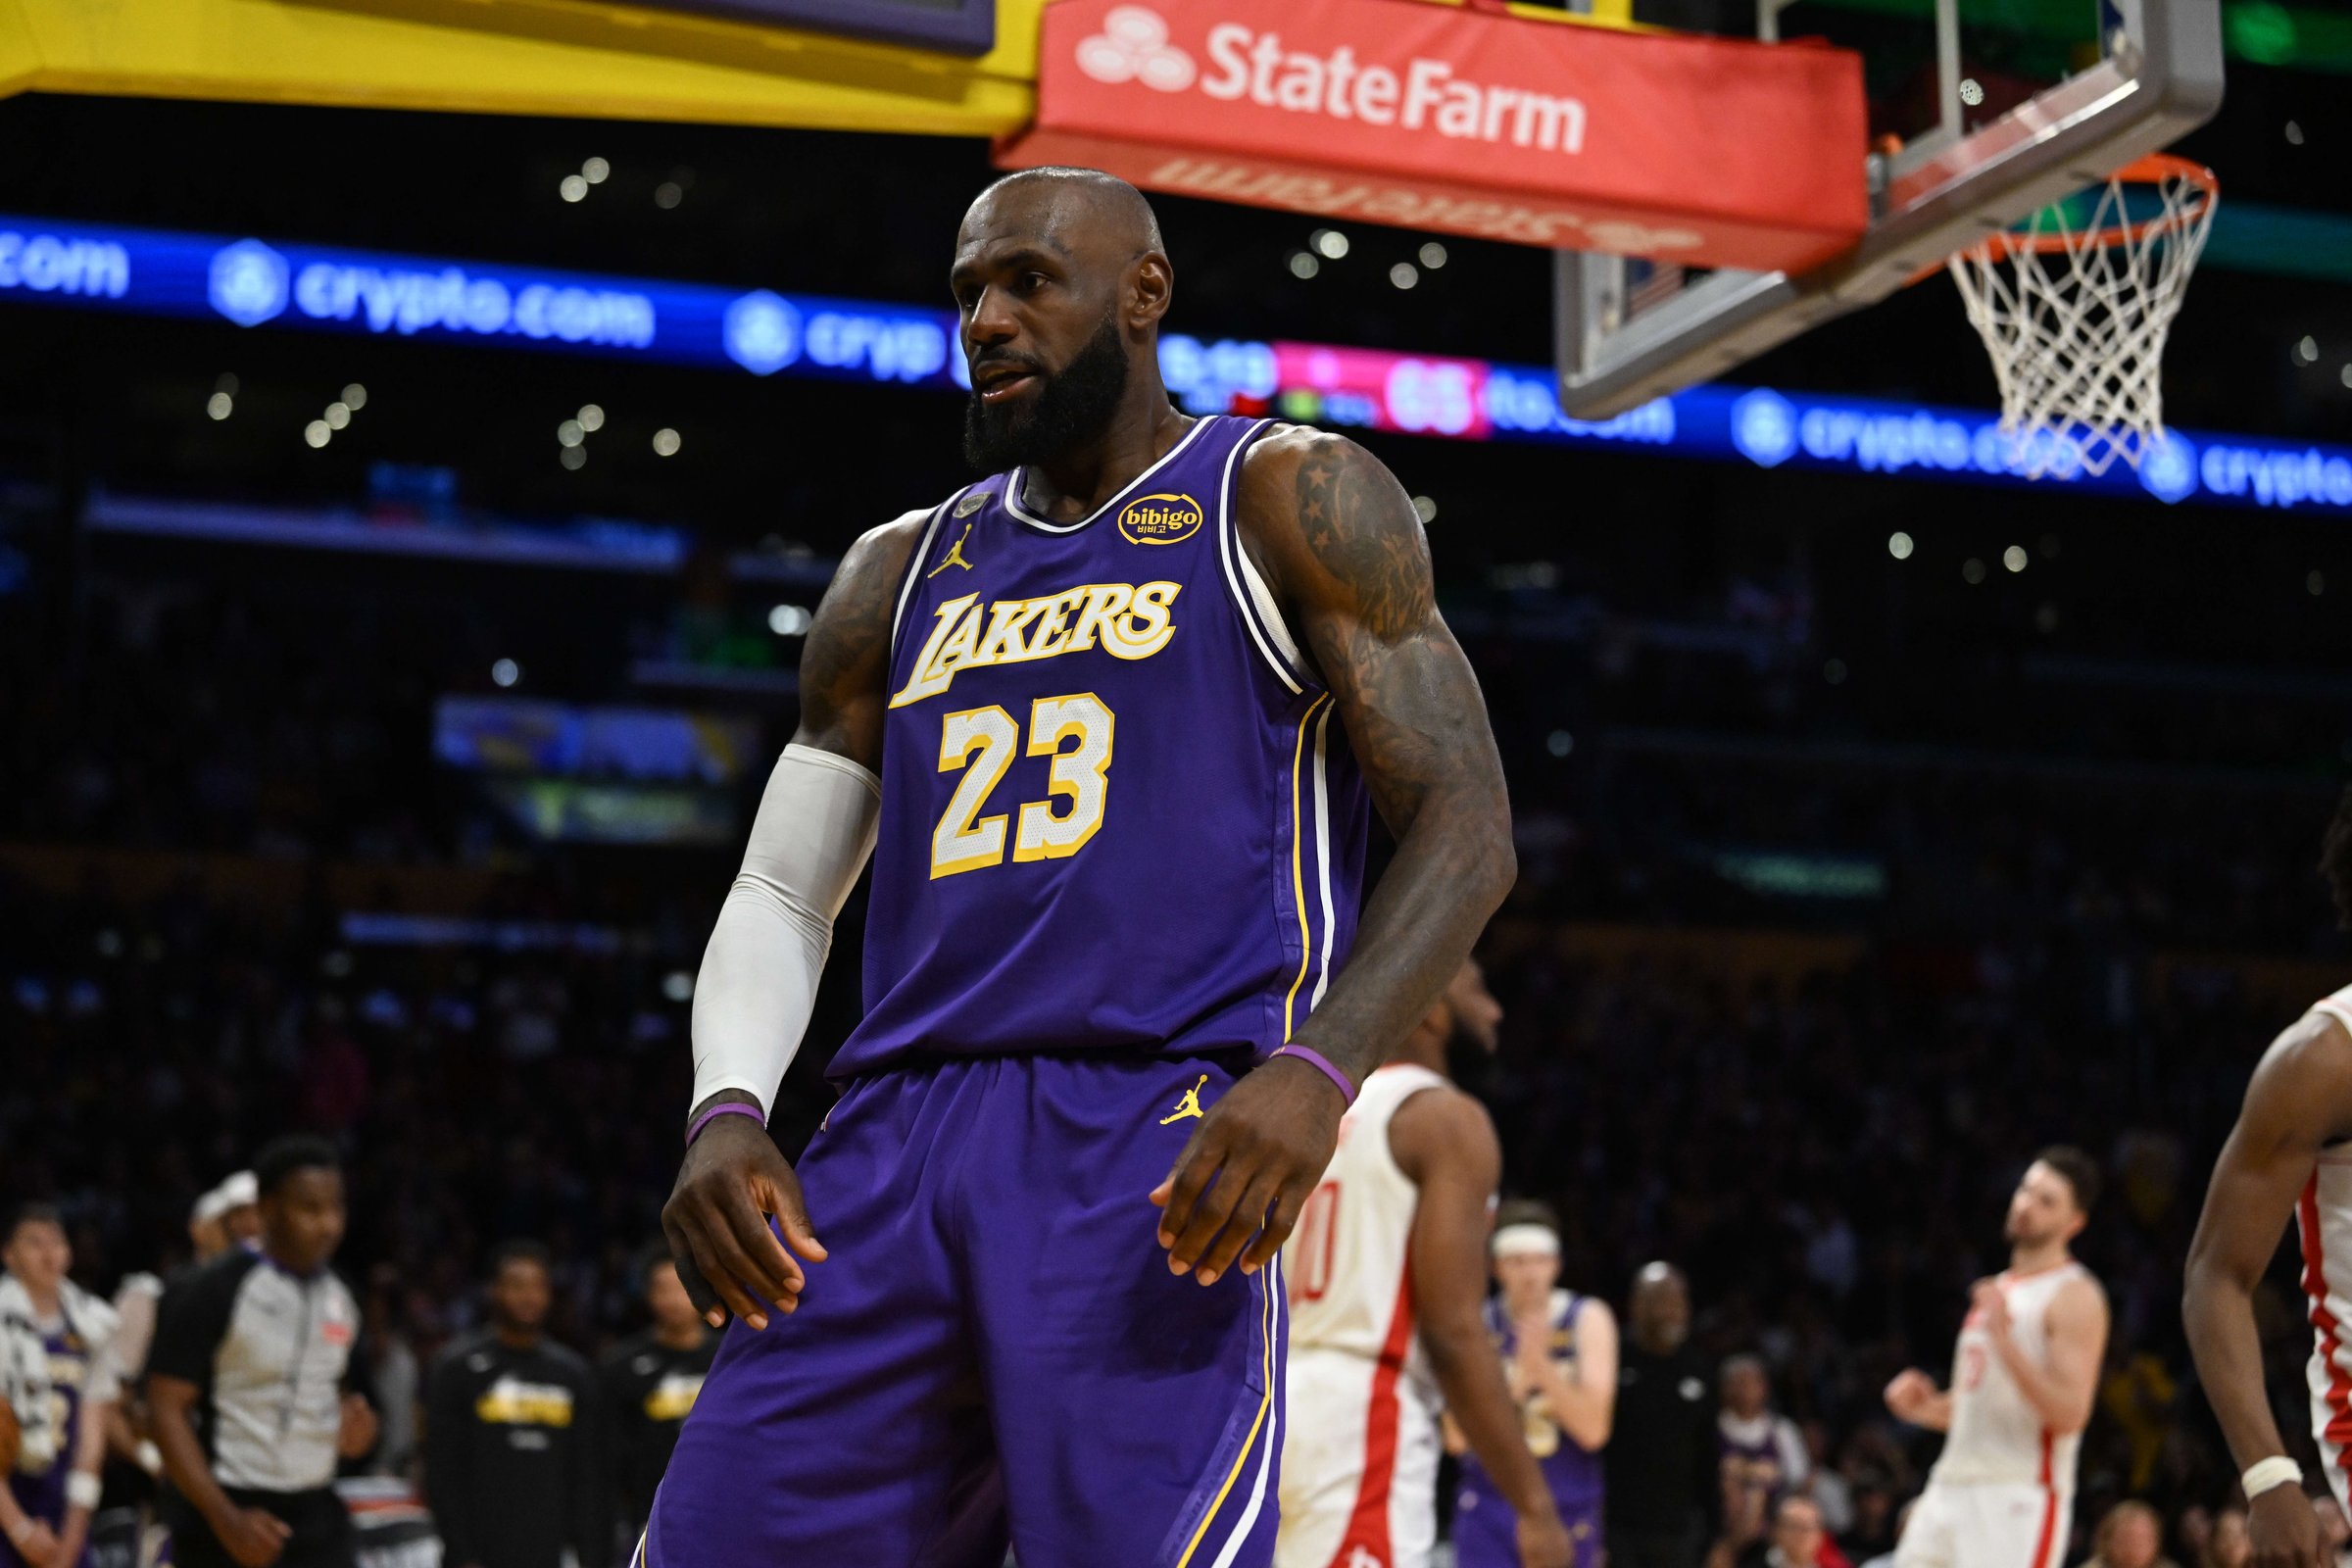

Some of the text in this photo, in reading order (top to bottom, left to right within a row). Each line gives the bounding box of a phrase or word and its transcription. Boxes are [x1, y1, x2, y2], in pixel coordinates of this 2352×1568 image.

[295, 262, 657, 350] crypto.com
[1126, 507, 1198, 530] bibigo
[1137, 525, 1167, 534] 비비고
[888, 580, 1184, 710] LAKERS
[929, 691, 1115, 880] 23
